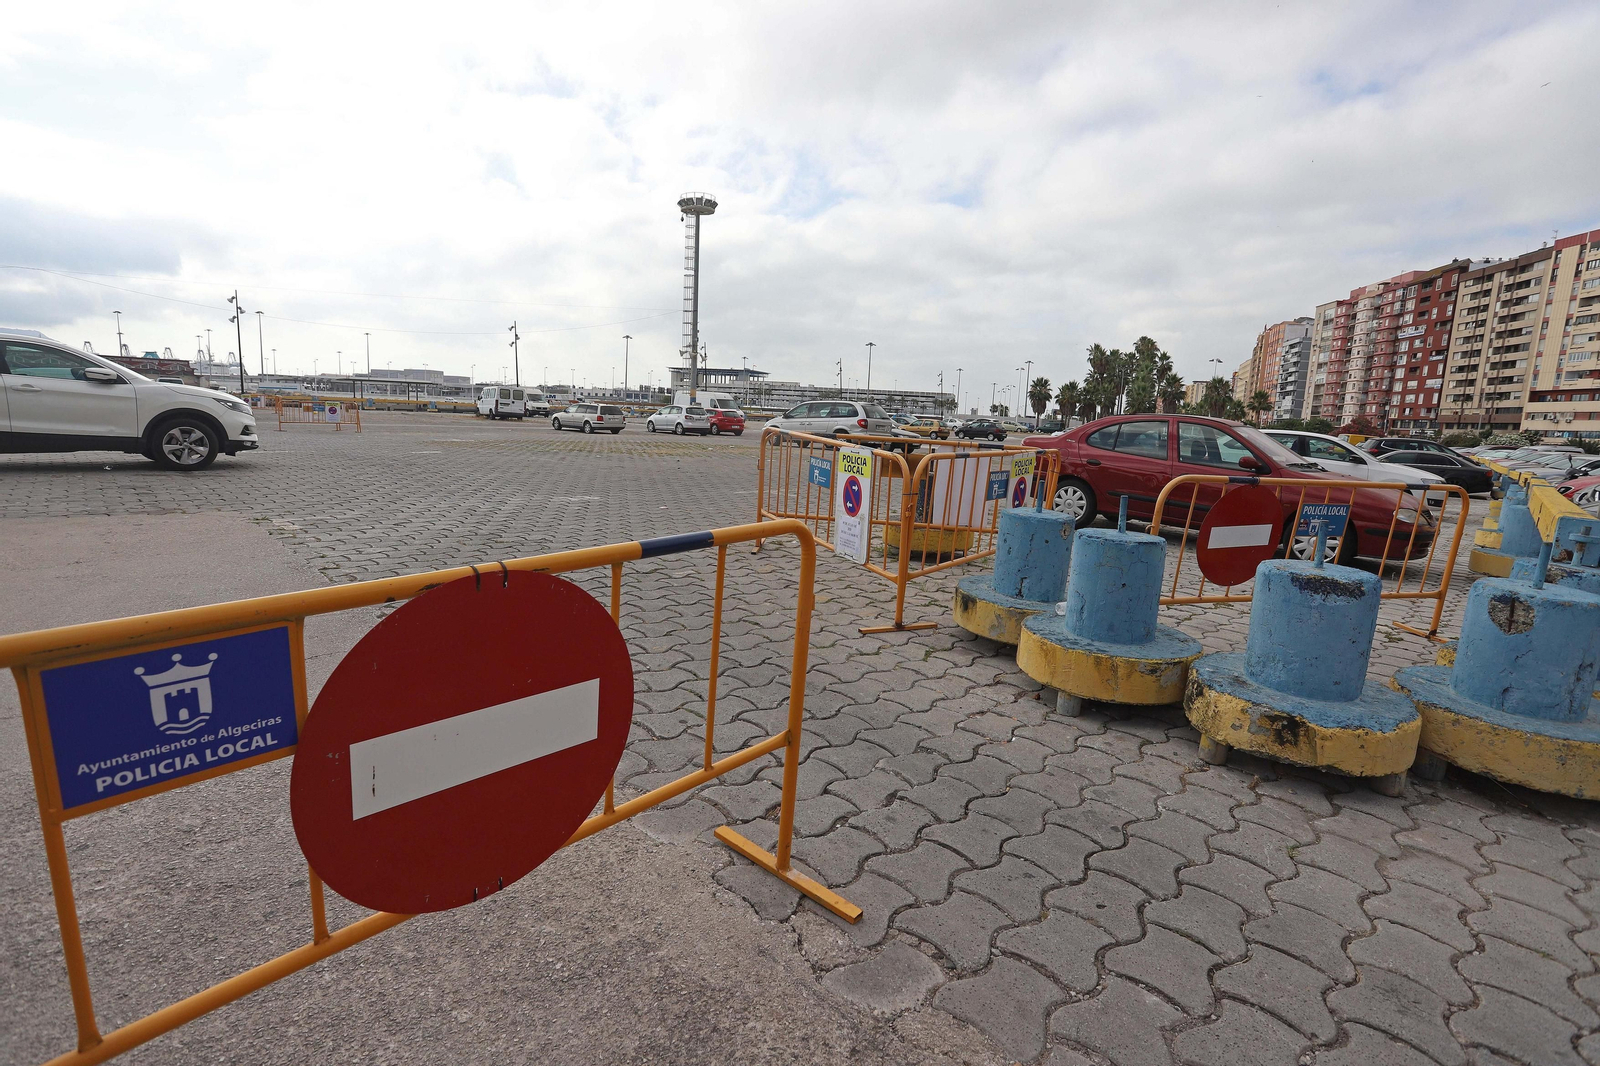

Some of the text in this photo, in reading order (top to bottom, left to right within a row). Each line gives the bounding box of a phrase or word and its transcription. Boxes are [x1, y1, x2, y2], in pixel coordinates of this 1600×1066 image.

[842, 454, 867, 467] POLICIA
[1014, 458, 1033, 469] POLICIA
[844, 464, 864, 476] LOCAL
[1015, 466, 1030, 477] LOCAL
[1303, 504, 1347, 516] POLICÍA LOCAL
[77, 715, 282, 776] Ayuntamiento de Algeciras
[95, 732, 278, 793] POLICIA LOCAL
